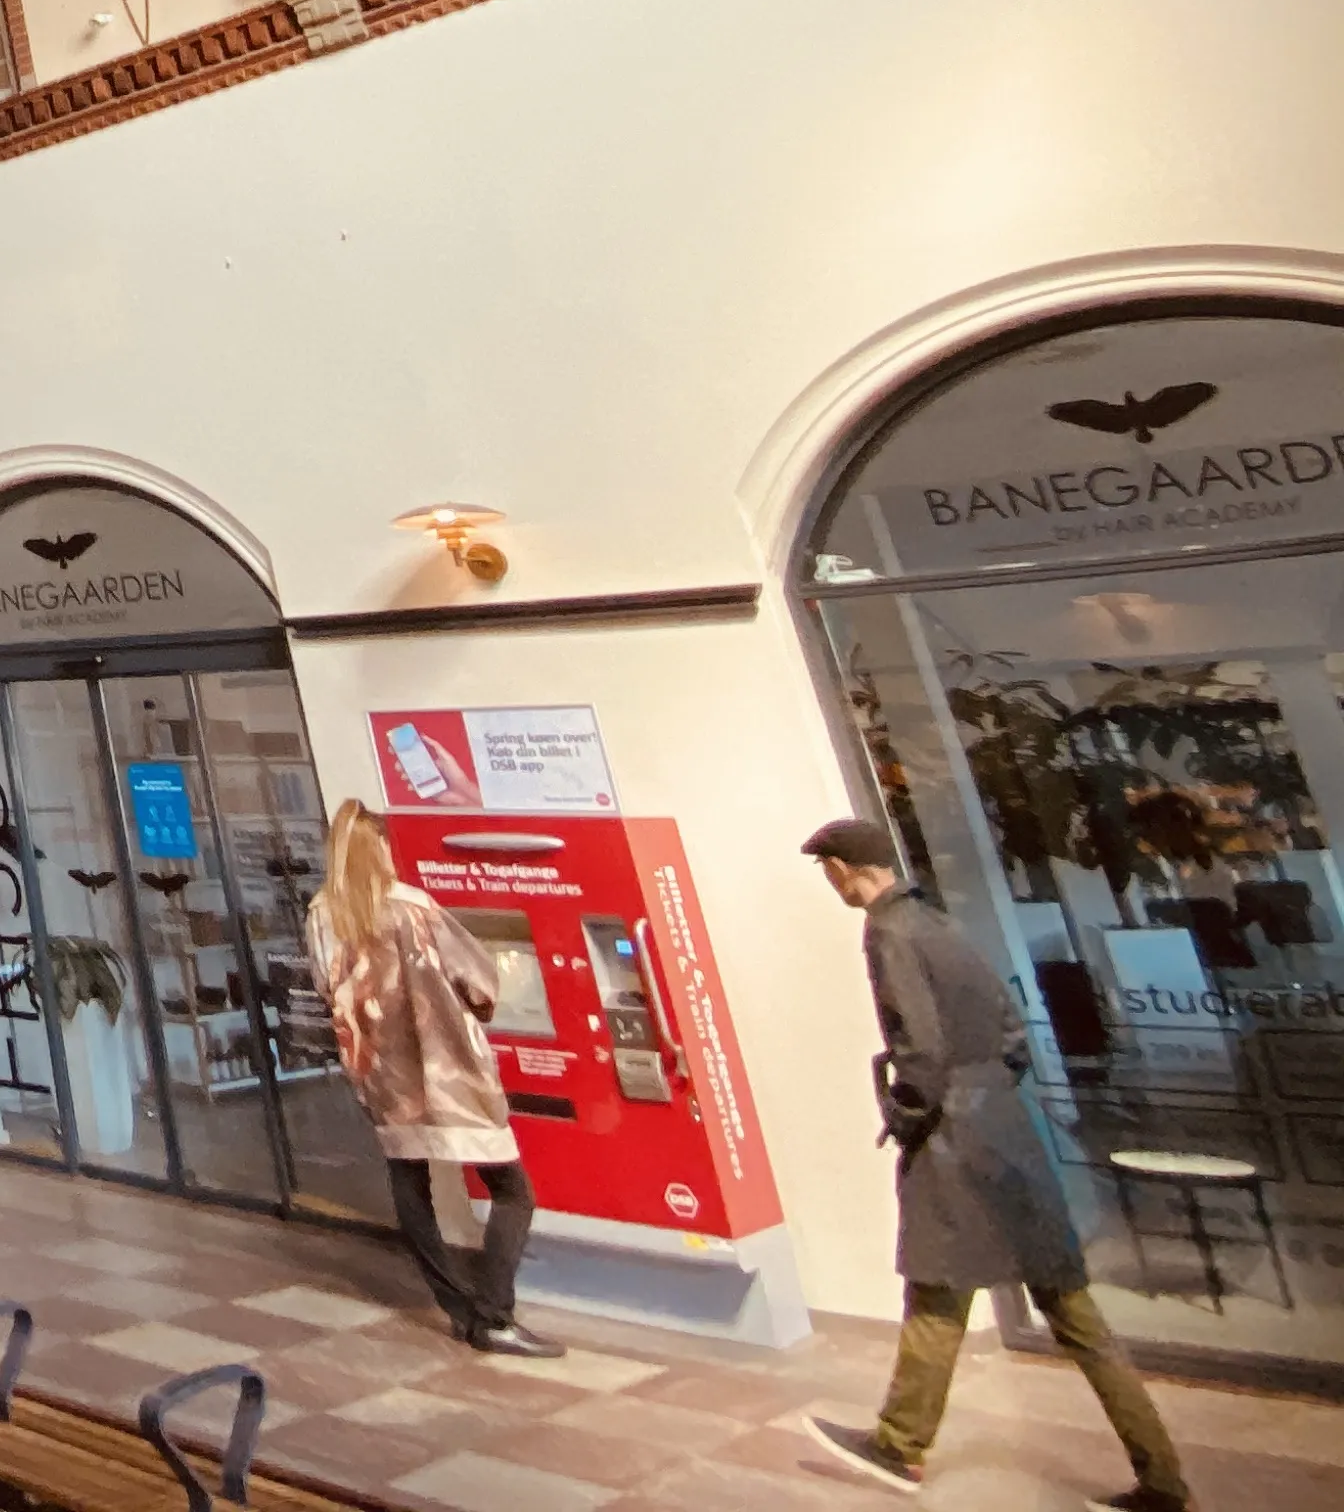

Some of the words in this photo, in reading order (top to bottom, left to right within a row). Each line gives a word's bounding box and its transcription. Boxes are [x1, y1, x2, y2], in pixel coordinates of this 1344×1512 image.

[1095, 513, 1154, 535] HAIR
[1165, 495, 1303, 528] ACADEMY
[484, 732, 526, 751] Spring
[516, 745, 538, 757] din
[540, 744, 573, 757] billet
[490, 760, 516, 772] DSB
[519, 761, 545, 774] app
[416, 860, 467, 876] Billetter
[470, 862, 482, 876] &
[484, 862, 560, 880] Togafgange
[421, 875, 463, 890] Tickets
[466, 879, 477, 892] &
[478, 877, 516, 893] Train
[512, 879, 584, 897] departures
[654, 866, 682, 950] Tickets
[685, 982, 708, 1041] Train
[702, 1045, 744, 1181] departures
